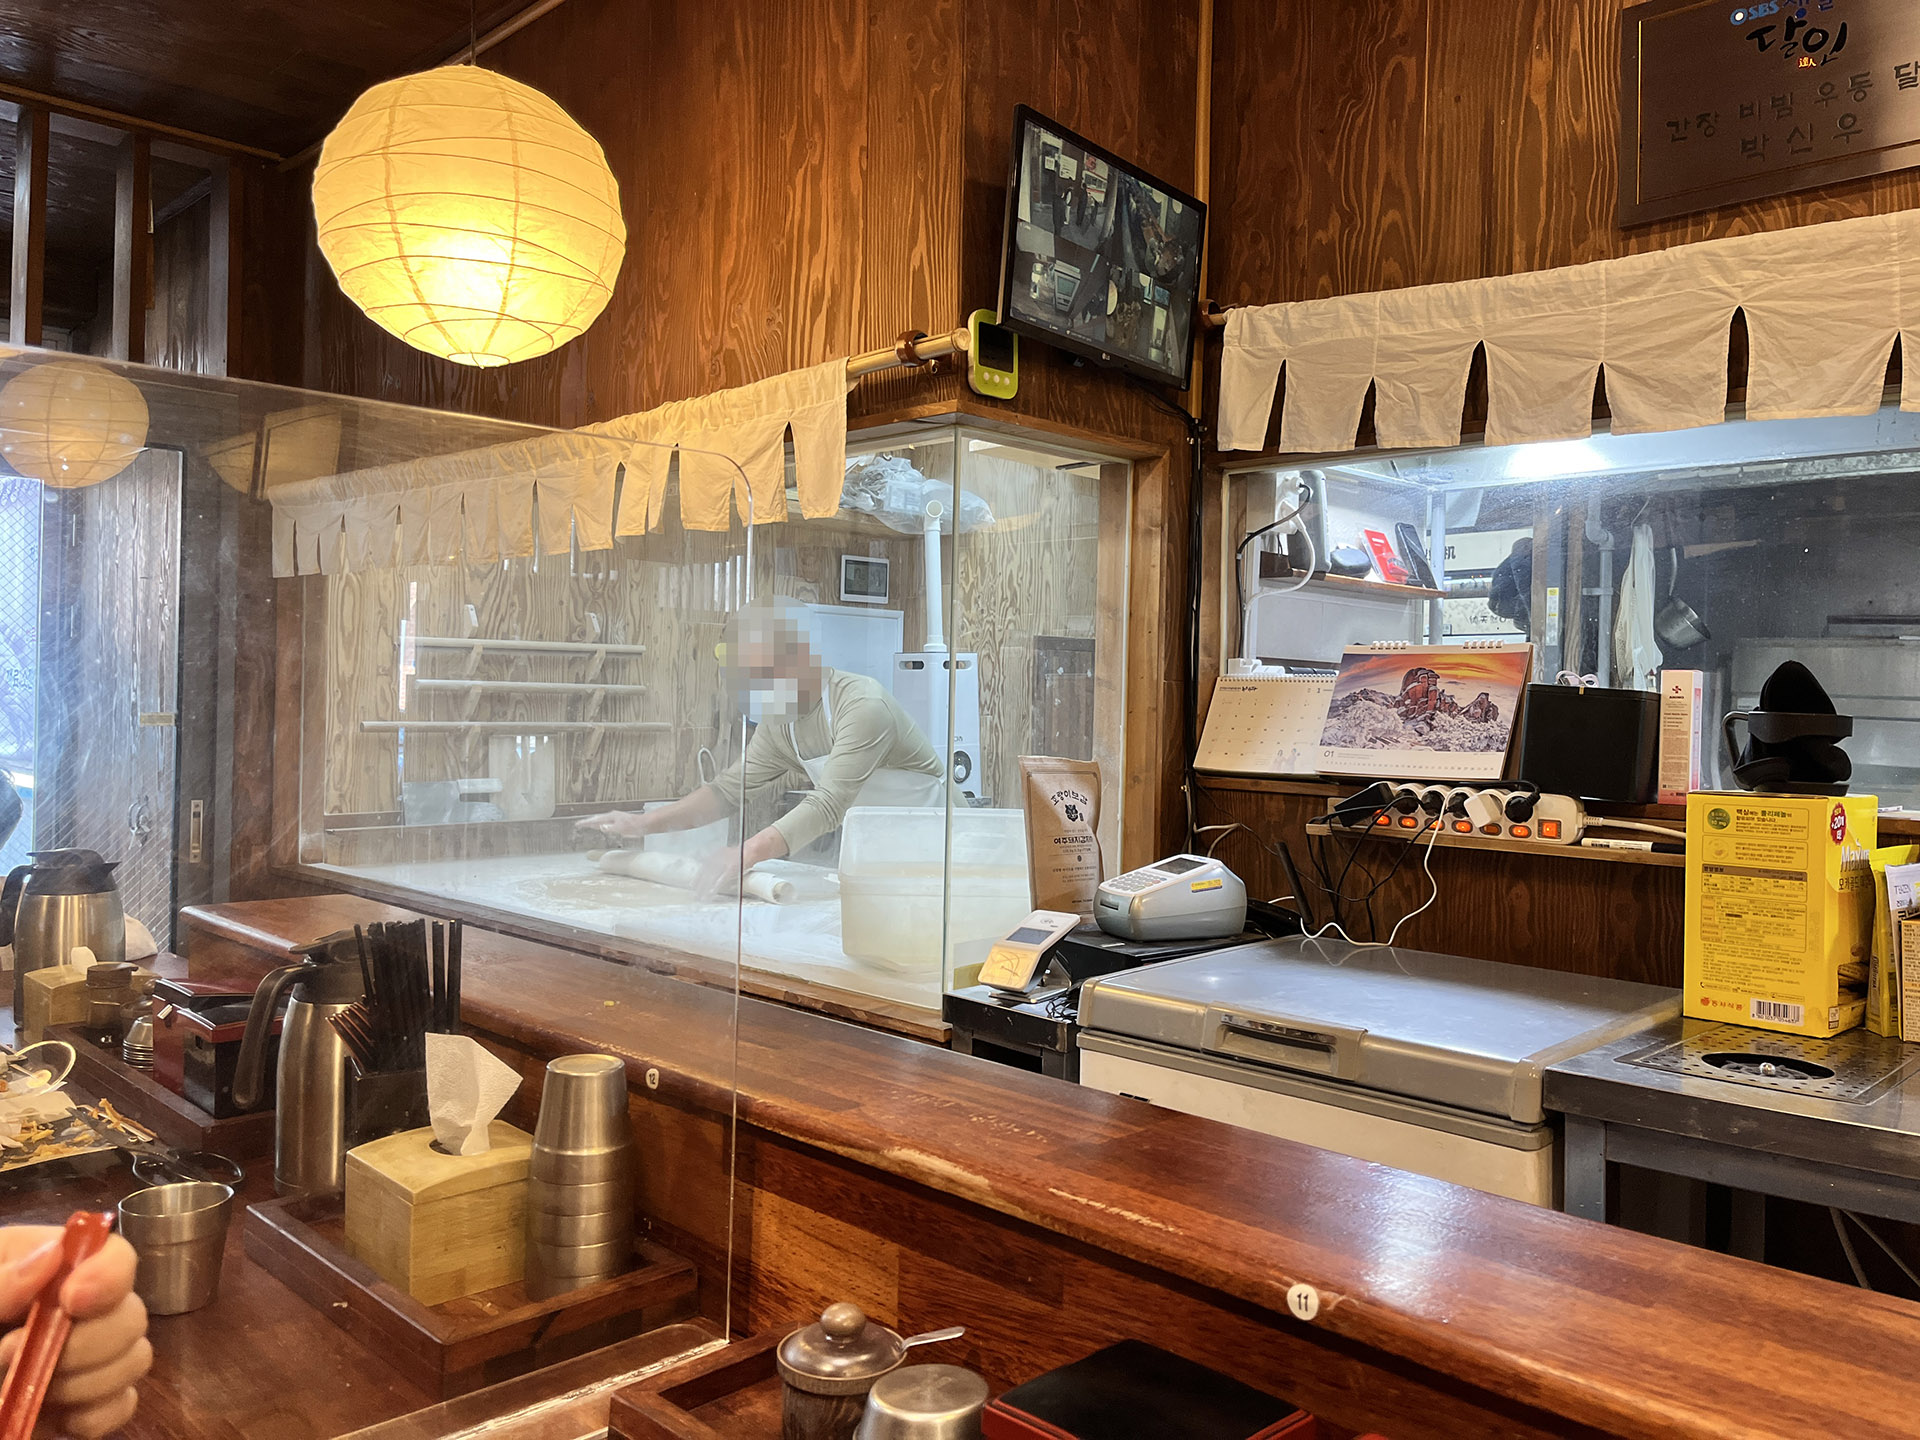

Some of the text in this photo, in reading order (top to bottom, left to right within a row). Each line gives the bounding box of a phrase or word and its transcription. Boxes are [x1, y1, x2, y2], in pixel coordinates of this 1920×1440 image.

[1748, 0, 1780, 20] SBS
[1745, 16, 1847, 67] 달인
[1666, 111, 1719, 142] 간장
[1738, 91, 1794, 122] 비빔
[1813, 71, 1873, 108] 우동
[1051, 789, 1088, 806] 호랑이보감
[648, 1073, 656, 1085] 12
[1297, 1292, 1309, 1312] 11
